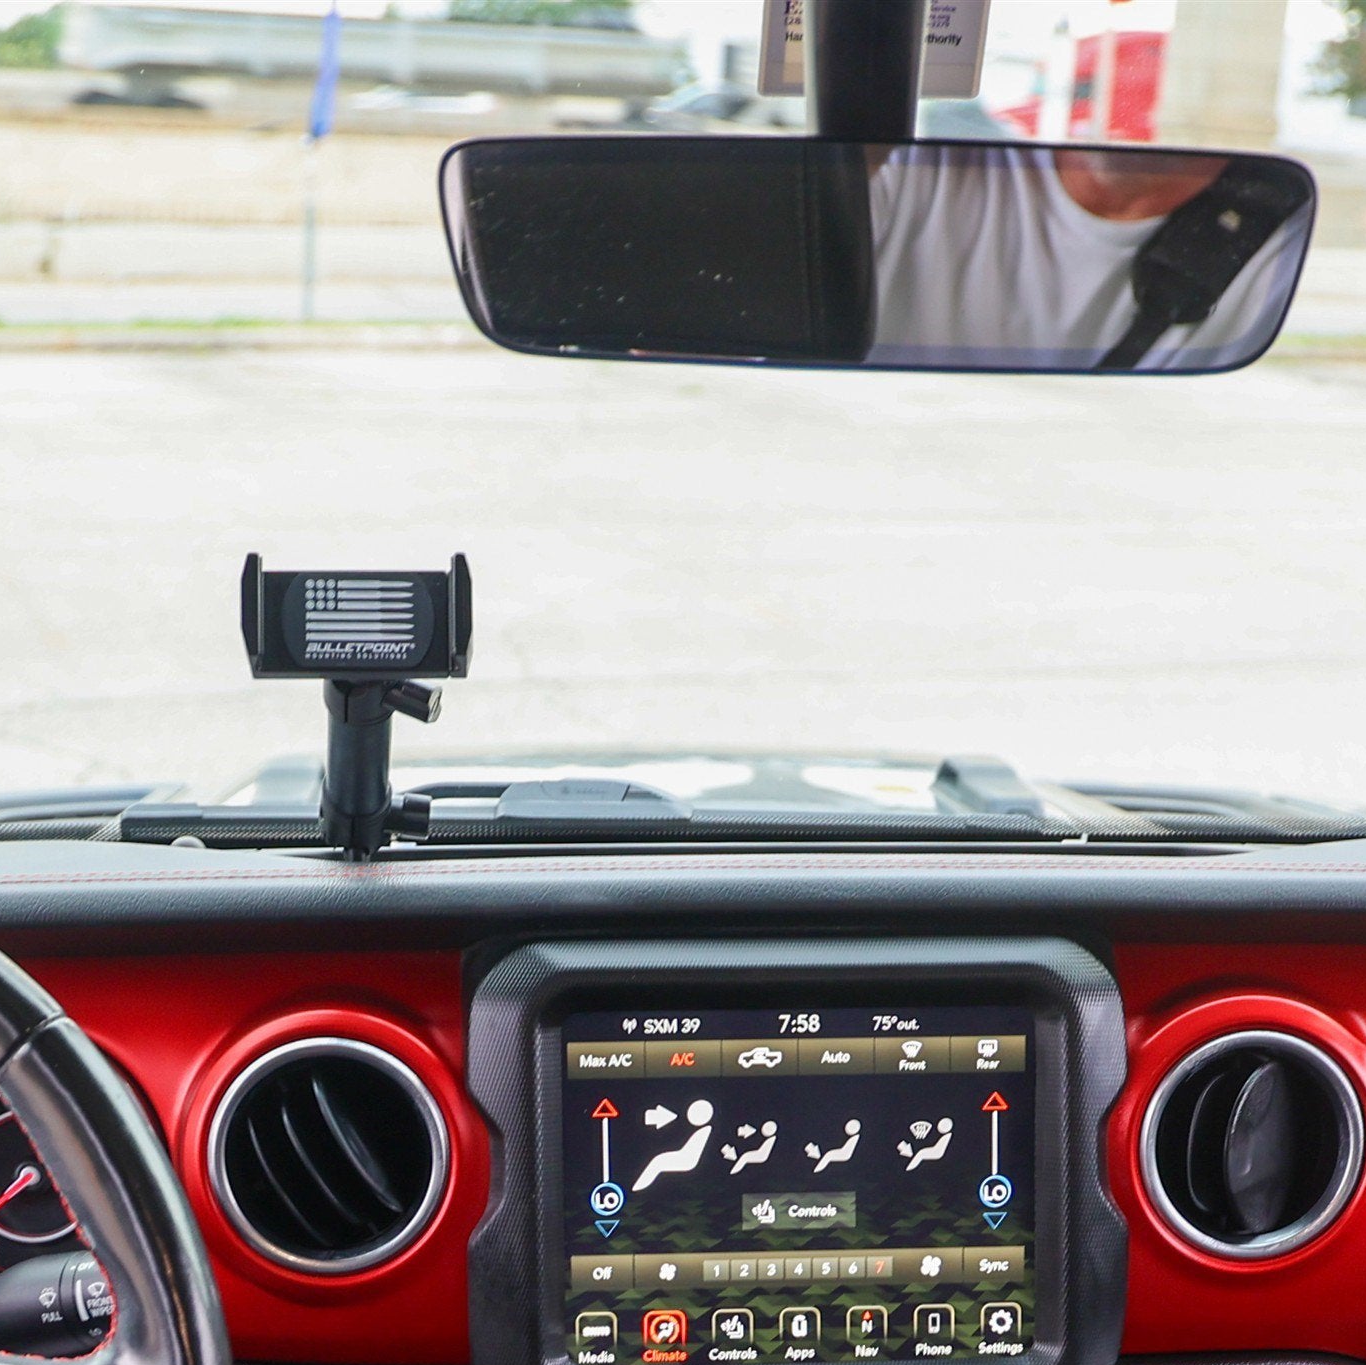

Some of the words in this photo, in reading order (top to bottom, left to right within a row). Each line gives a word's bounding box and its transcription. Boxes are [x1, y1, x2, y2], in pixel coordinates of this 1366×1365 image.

[643, 1018, 677, 1034] SXM
[681, 1017, 701, 1034] 39
[778, 1013, 821, 1034] 7:58
[579, 1054, 607, 1068] Max
[608, 1053, 633, 1068] A/C
[669, 1052, 695, 1067] A/C
[820, 1050, 851, 1065] Auto
[976, 1058, 1000, 1071] Rear
[898, 1059, 926, 1072] Front
[982, 1184, 1009, 1202] LO
[594, 1192, 620, 1210] LO
[788, 1203, 838, 1218] Controls
[713, 1265, 721, 1278] 1
[739, 1264, 750, 1277] 2
[767, 1263, 777, 1277] 3
[794, 1263, 804, 1276] 4
[821, 1262, 831, 1275] 5
[848, 1261, 858, 1274] 6
[875, 1260, 886, 1273] 7
[979, 1257, 1010, 1274] Sync
[592, 1265, 614, 1282] Off
[708, 1347, 758, 1361] Controls
[784, 1347, 816, 1362] Apps
[855, 1345, 879, 1358] Nav
[915, 1343, 953, 1357] Phone
[978, 1341, 1024, 1356] Settings
[578, 1350, 616, 1365] Media
[642, 1349, 687, 1363] Climate
